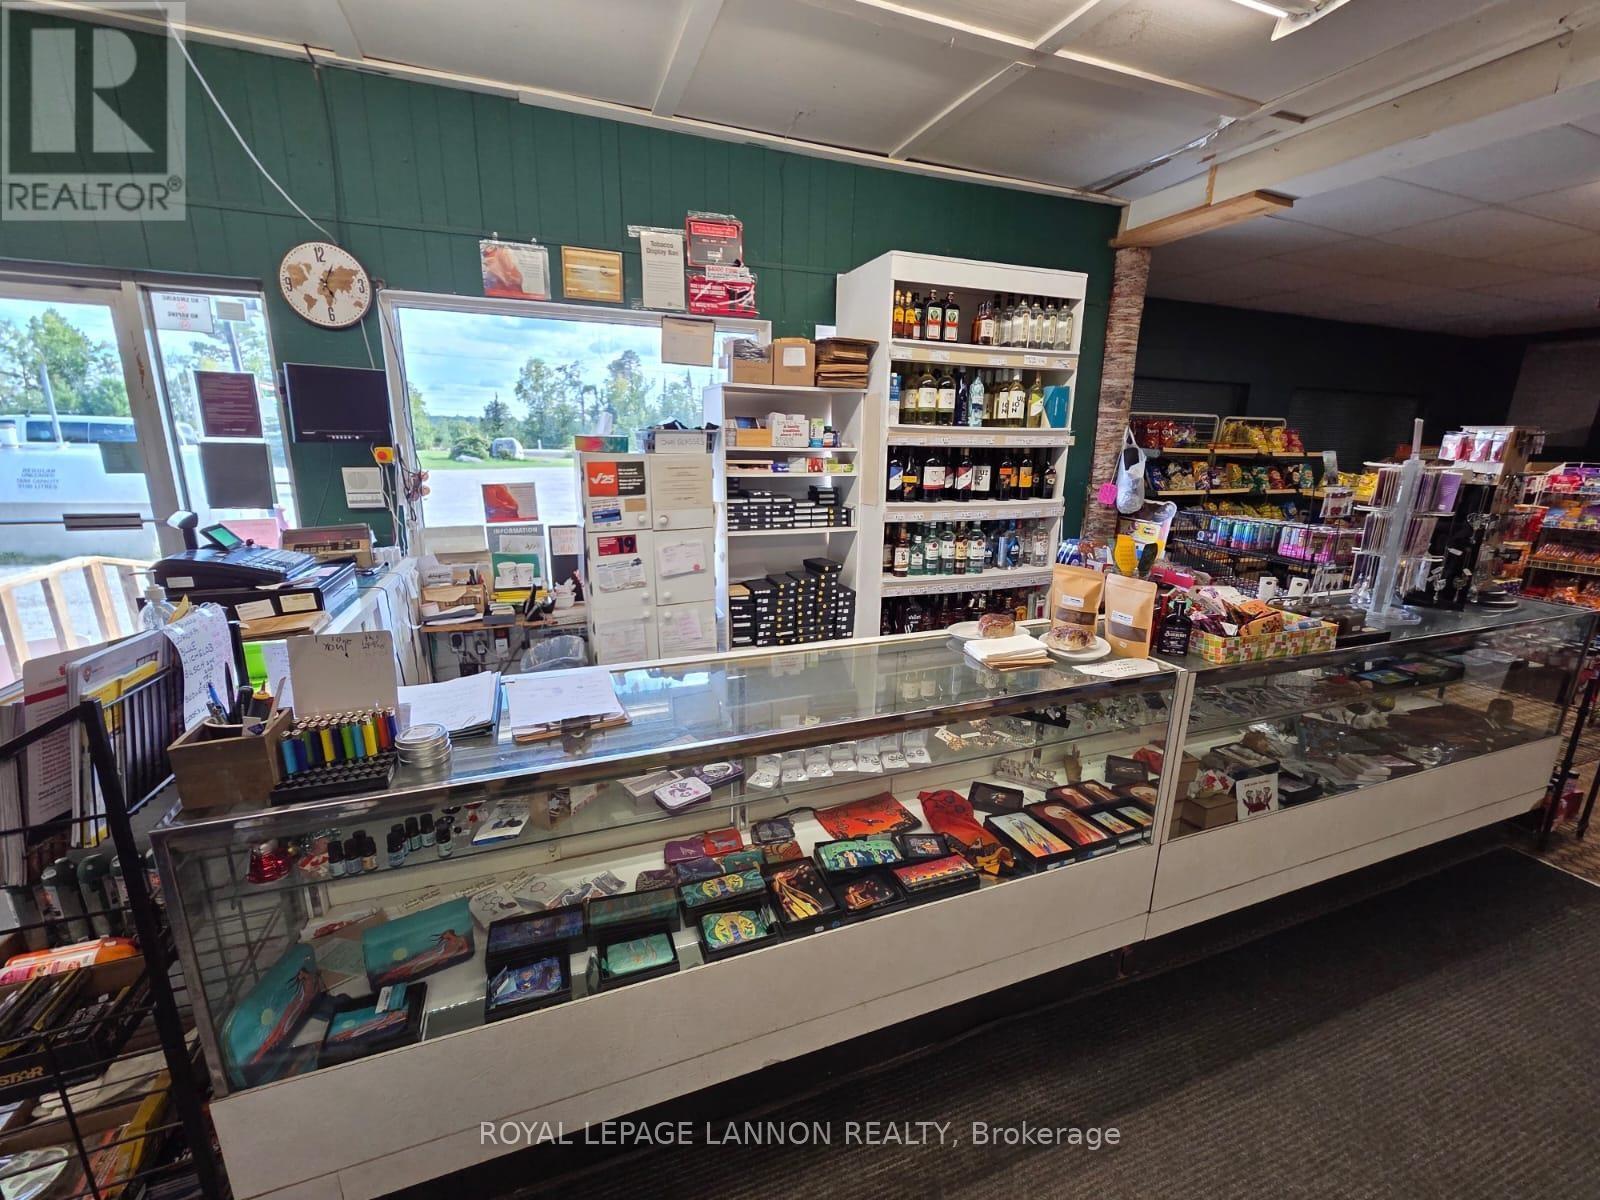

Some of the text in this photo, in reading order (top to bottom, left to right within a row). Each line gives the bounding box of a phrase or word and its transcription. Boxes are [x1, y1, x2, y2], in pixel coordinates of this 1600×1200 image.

[313, 246, 326, 263] 12
[284, 276, 293, 292] 9
[357, 279, 365, 294] 3
[327, 306, 336, 321] 6
[618, 535, 635, 553] 19
